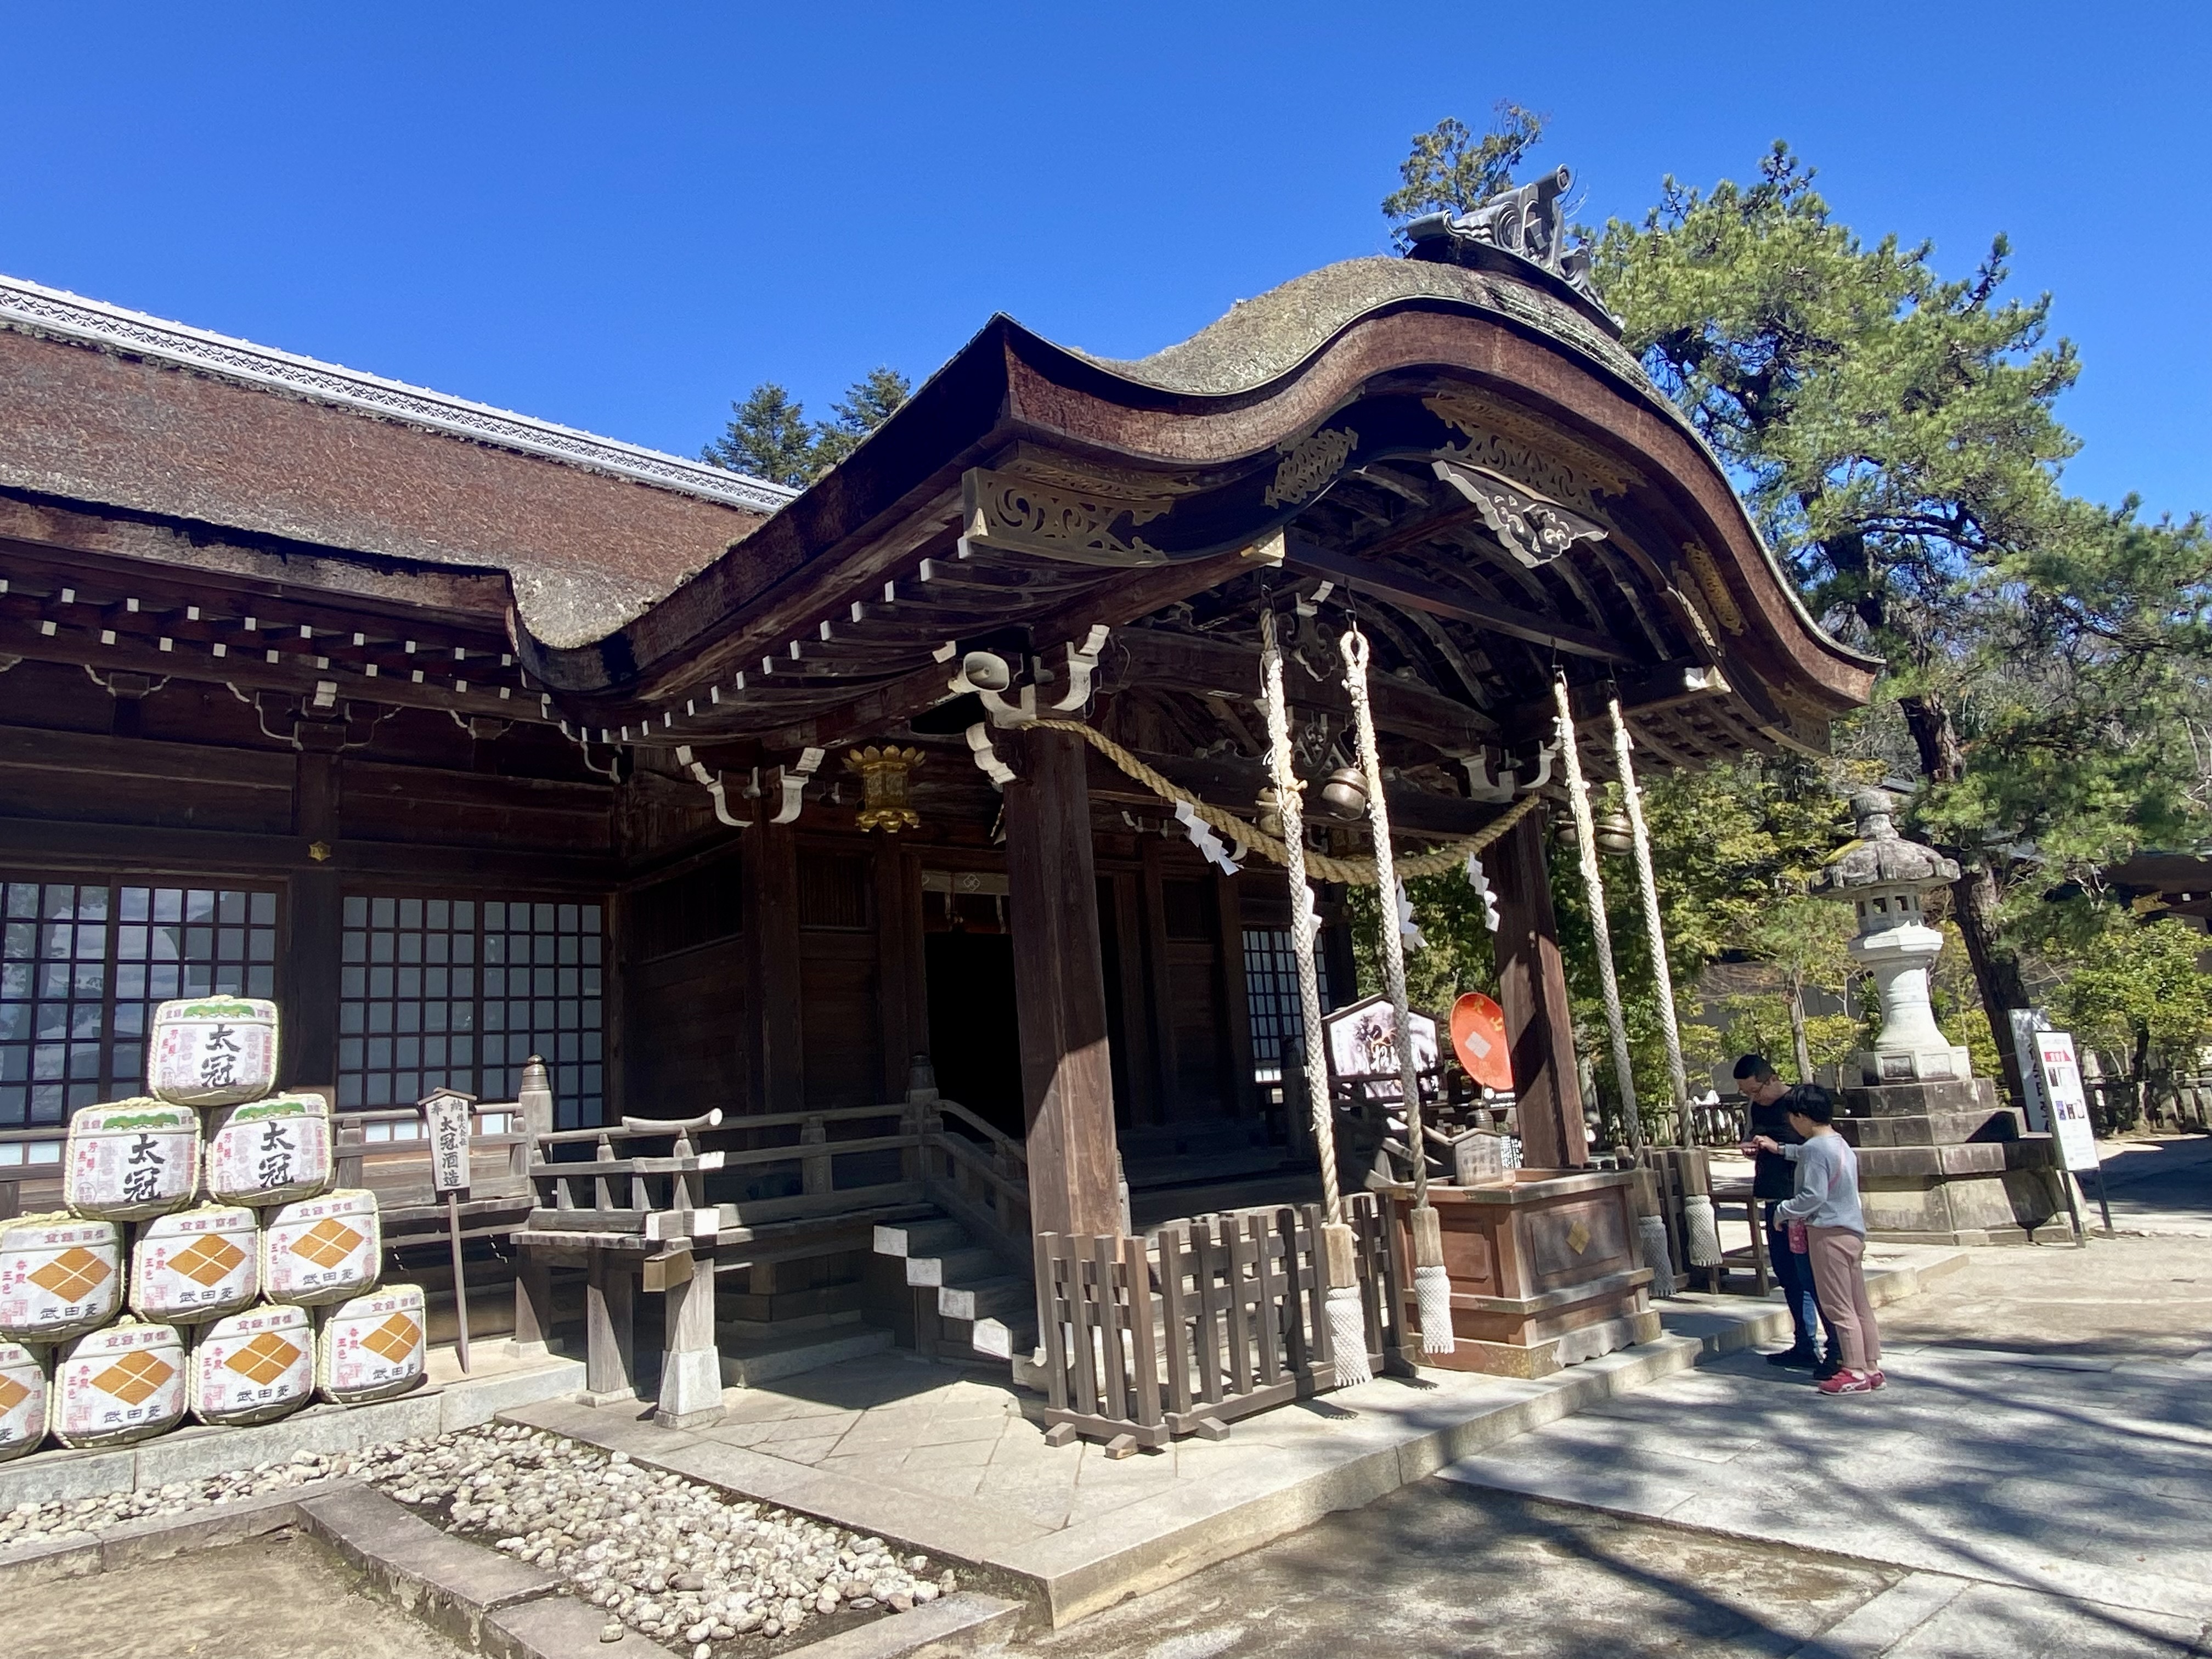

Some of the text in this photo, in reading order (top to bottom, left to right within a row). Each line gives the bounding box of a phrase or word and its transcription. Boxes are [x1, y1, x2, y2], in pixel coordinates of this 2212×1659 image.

[201, 1024, 241, 1087] 太冠
[431, 1099, 464, 1116] 奉納
[457, 1113, 467, 1147] 株式会社
[259, 1120, 297, 1188] 太冠
[440, 1116, 461, 1187] 太冠酒造
[123, 1134, 166, 1203] 太冠
[303, 1268, 354, 1286] 武田菱
[179, 1287, 234, 1304] 武田菱
[40, 1303, 98, 1321] 武田菱
[373, 1363, 415, 1380] 武田菱
[236, 1385, 290, 1403] 武田菱
[104, 1404, 161, 1423] 武田菱
